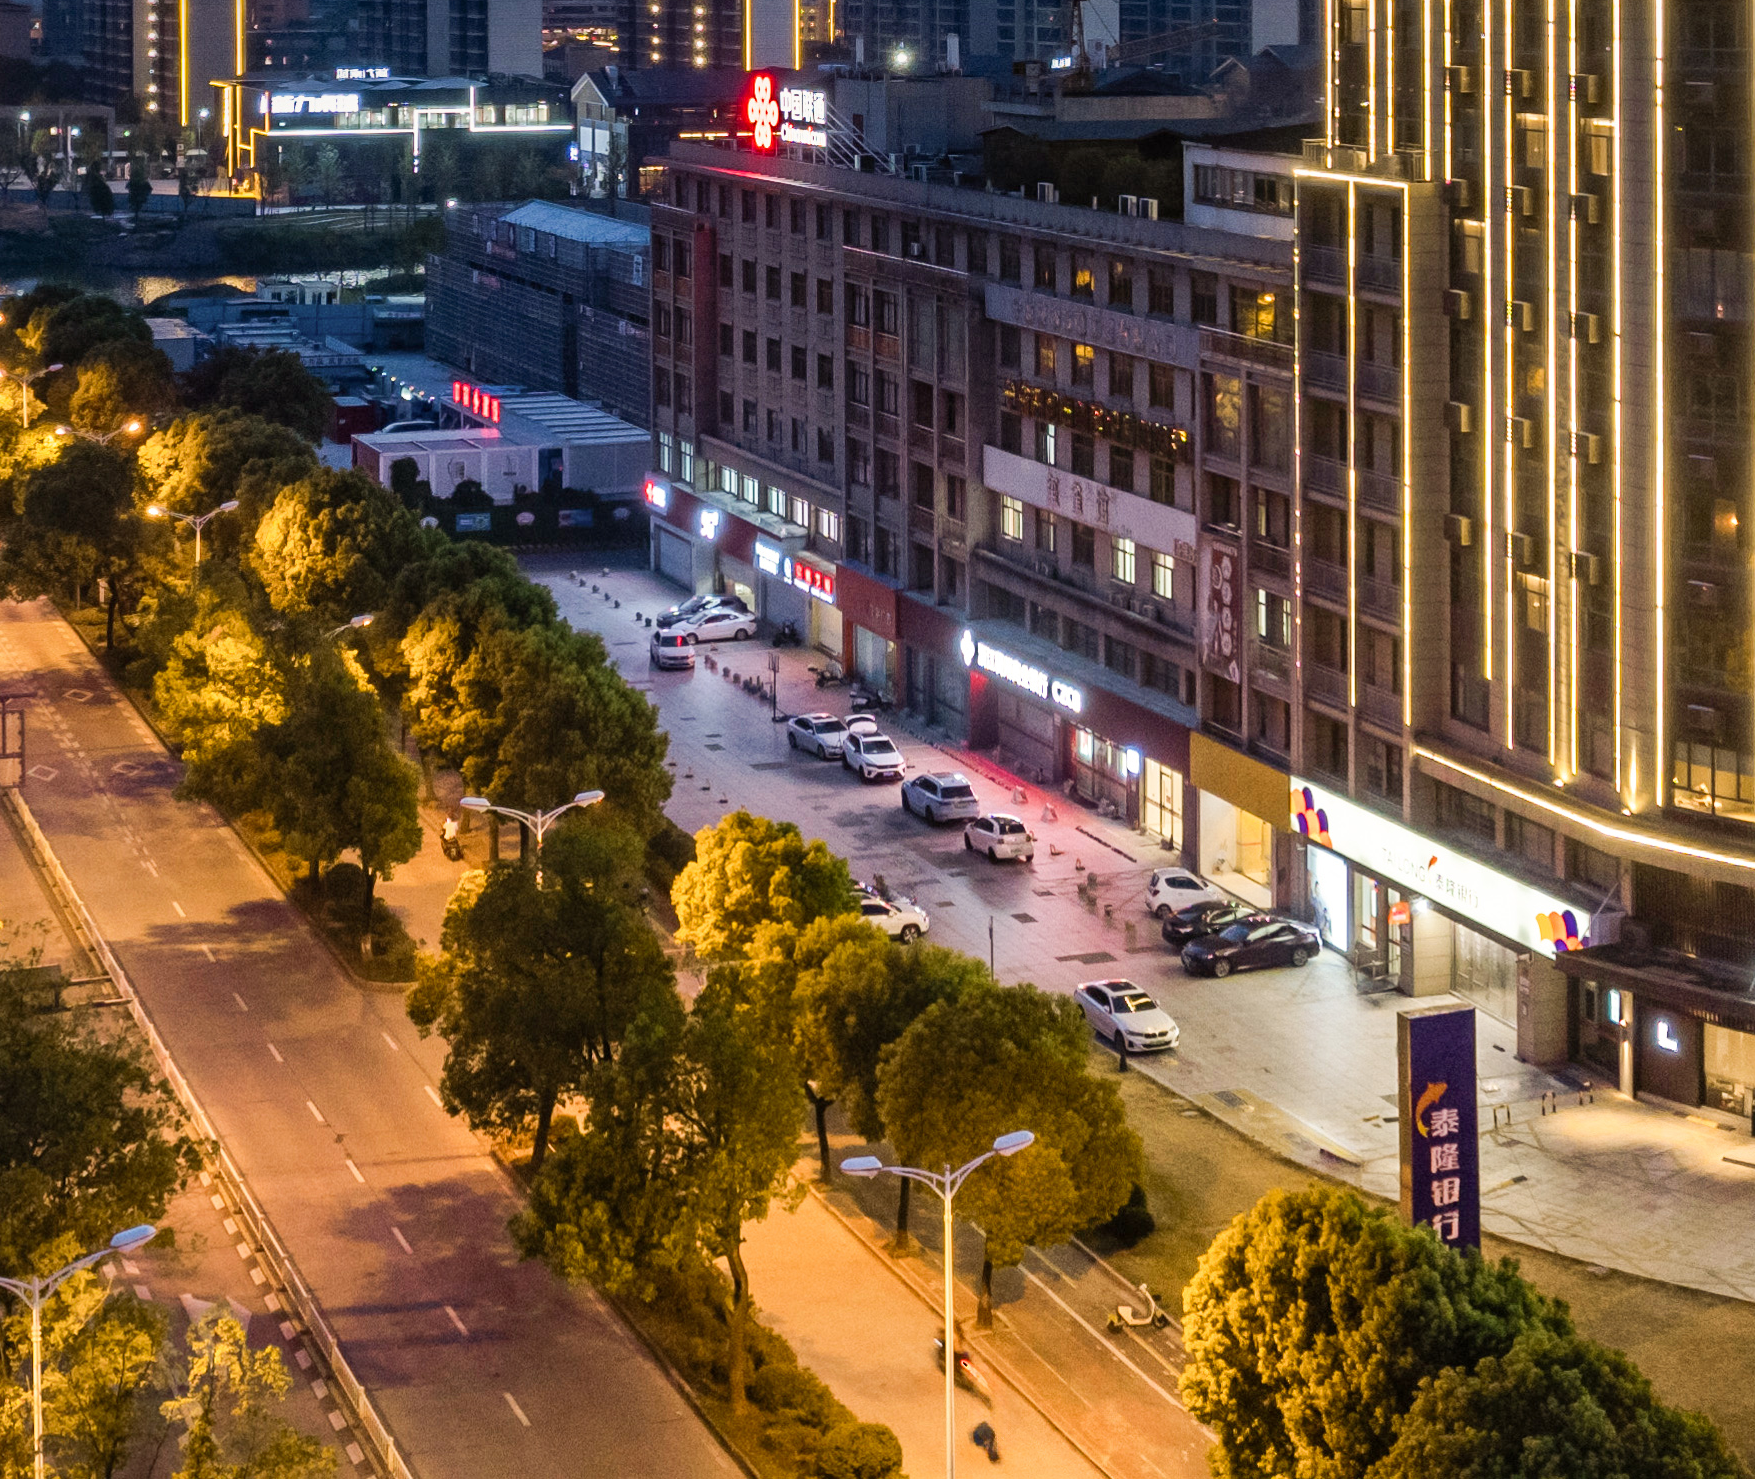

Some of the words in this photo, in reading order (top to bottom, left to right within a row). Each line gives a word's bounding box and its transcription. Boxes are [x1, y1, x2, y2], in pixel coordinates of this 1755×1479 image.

[780, 88, 826, 125] 中国联通
[1430, 1108, 1461, 1241] 泰隆银行
